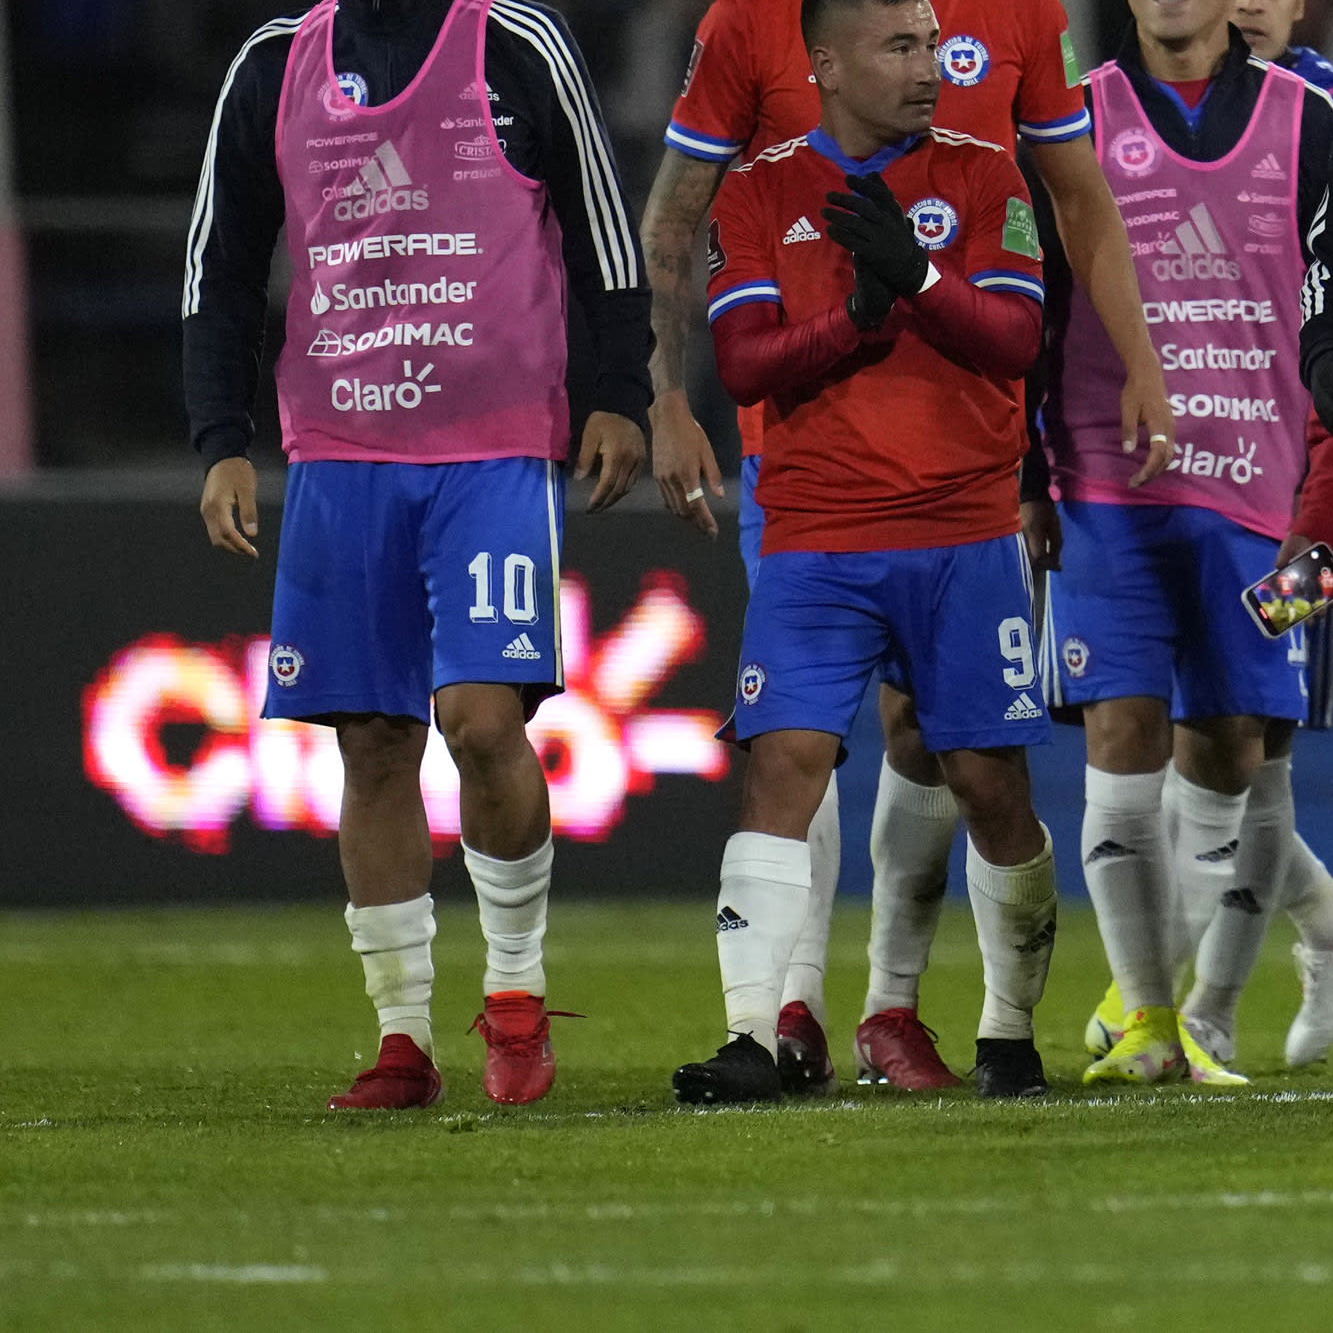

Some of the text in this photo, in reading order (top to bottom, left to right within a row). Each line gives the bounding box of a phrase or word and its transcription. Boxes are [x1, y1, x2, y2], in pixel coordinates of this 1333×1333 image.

[455, 115, 514, 129] Santnder
[334, 185, 430, 222] adidas
[783, 230, 821, 246] adidas
[1152, 254, 1241, 282] adidas
[331, 276, 477, 311] Santander
[340, 322, 473, 356] SODIMAC
[331, 376, 422, 412] Claro
[468, 551, 539, 626] 10
[502, 645, 541, 660] adidas
[998, 616, 1038, 691] 9
[1004, 708, 1043, 721] adidas
